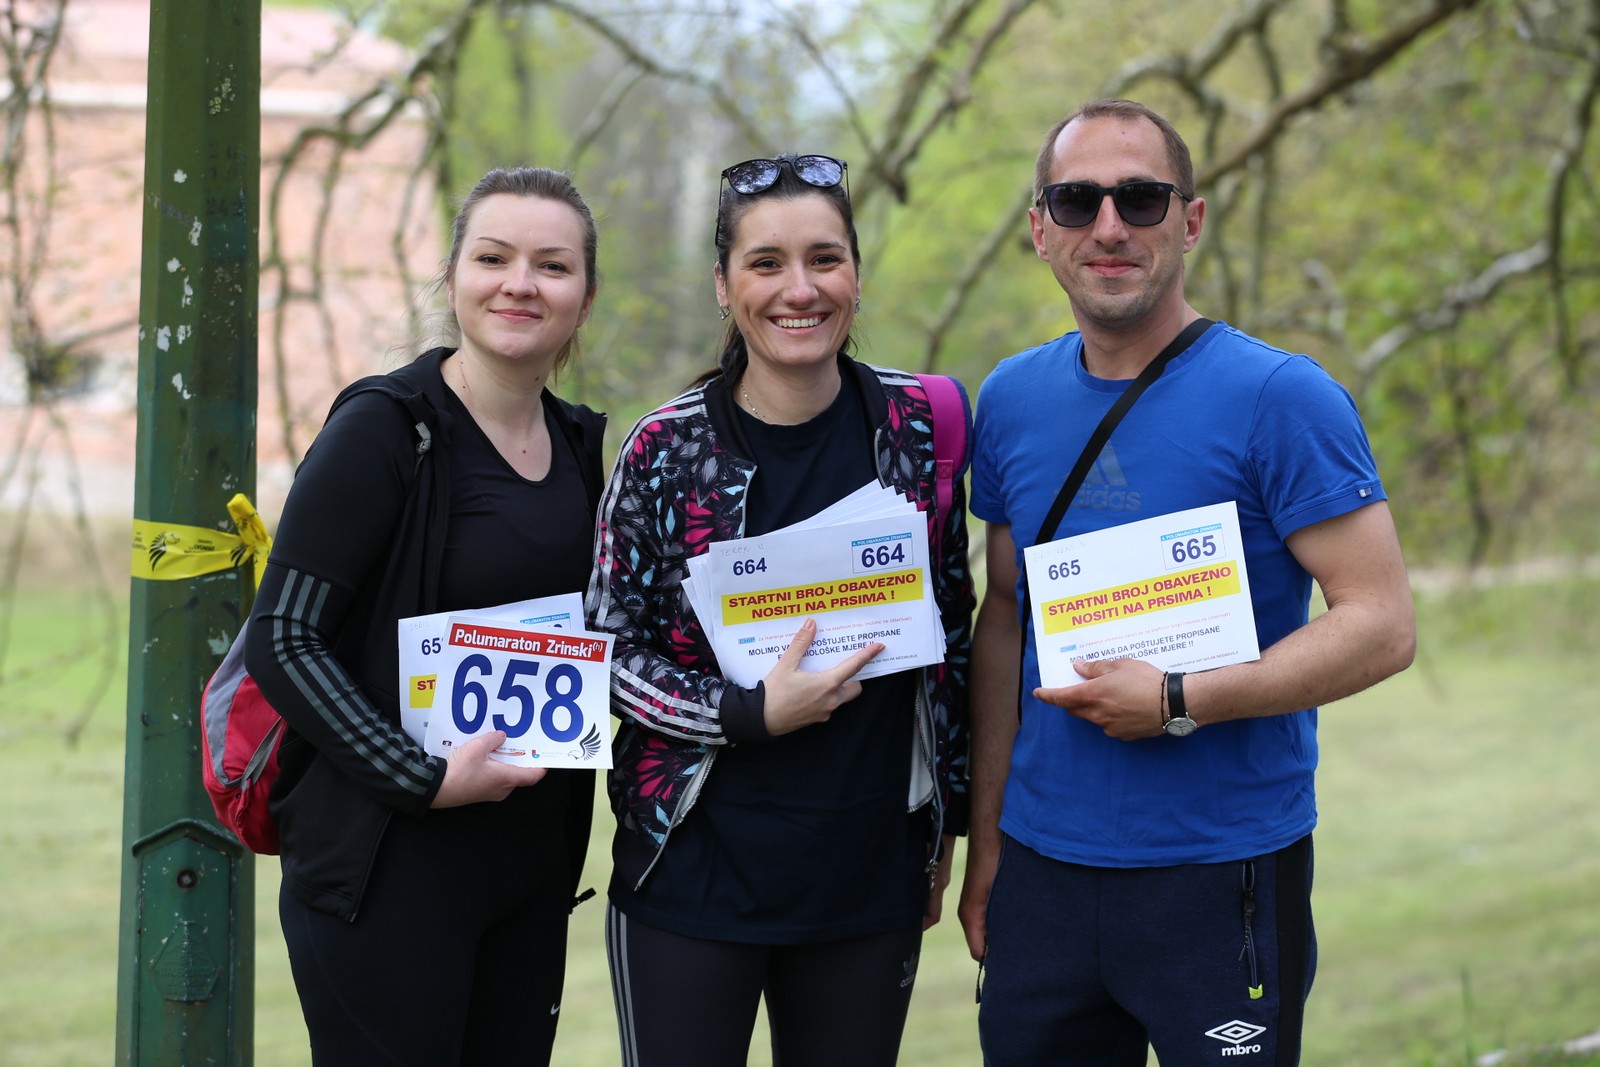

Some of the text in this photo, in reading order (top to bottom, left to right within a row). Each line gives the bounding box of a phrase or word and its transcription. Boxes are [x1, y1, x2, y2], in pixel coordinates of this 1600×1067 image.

[1053, 483, 1141, 511] didas
[861, 542, 905, 568] 664
[1172, 535, 1217, 562] 665
[733, 557, 767, 576] 664
[1048, 559, 1081, 580] 665
[728, 573, 916, 608] STARTNI BROJ OBAVEZNO
[1048, 567, 1232, 616] STARTNI BROJ OBAVEZNO
[752, 590, 895, 619] NOSITI NA PRSIMA !
[1072, 586, 1212, 626] NOSITI NA PRSIMA !
[421, 637, 444, 656] 65
[455, 628, 540, 652] Polumaraton
[749, 646, 780, 656] MOLIMO
[812, 635, 856, 647] POŠTUJETE
[858, 629, 901, 640] PROPISANE
[843, 642, 867, 653] MJERE
[1101, 648, 1115, 656] VAS
[1130, 636, 1174, 650] POŠTUJETE
[1176, 625, 1220, 640] PROPISANE
[1161, 642, 1187, 653] MJERE
[452, 654, 584, 743] 658
[1222, 1044, 1261, 1056] mbro
